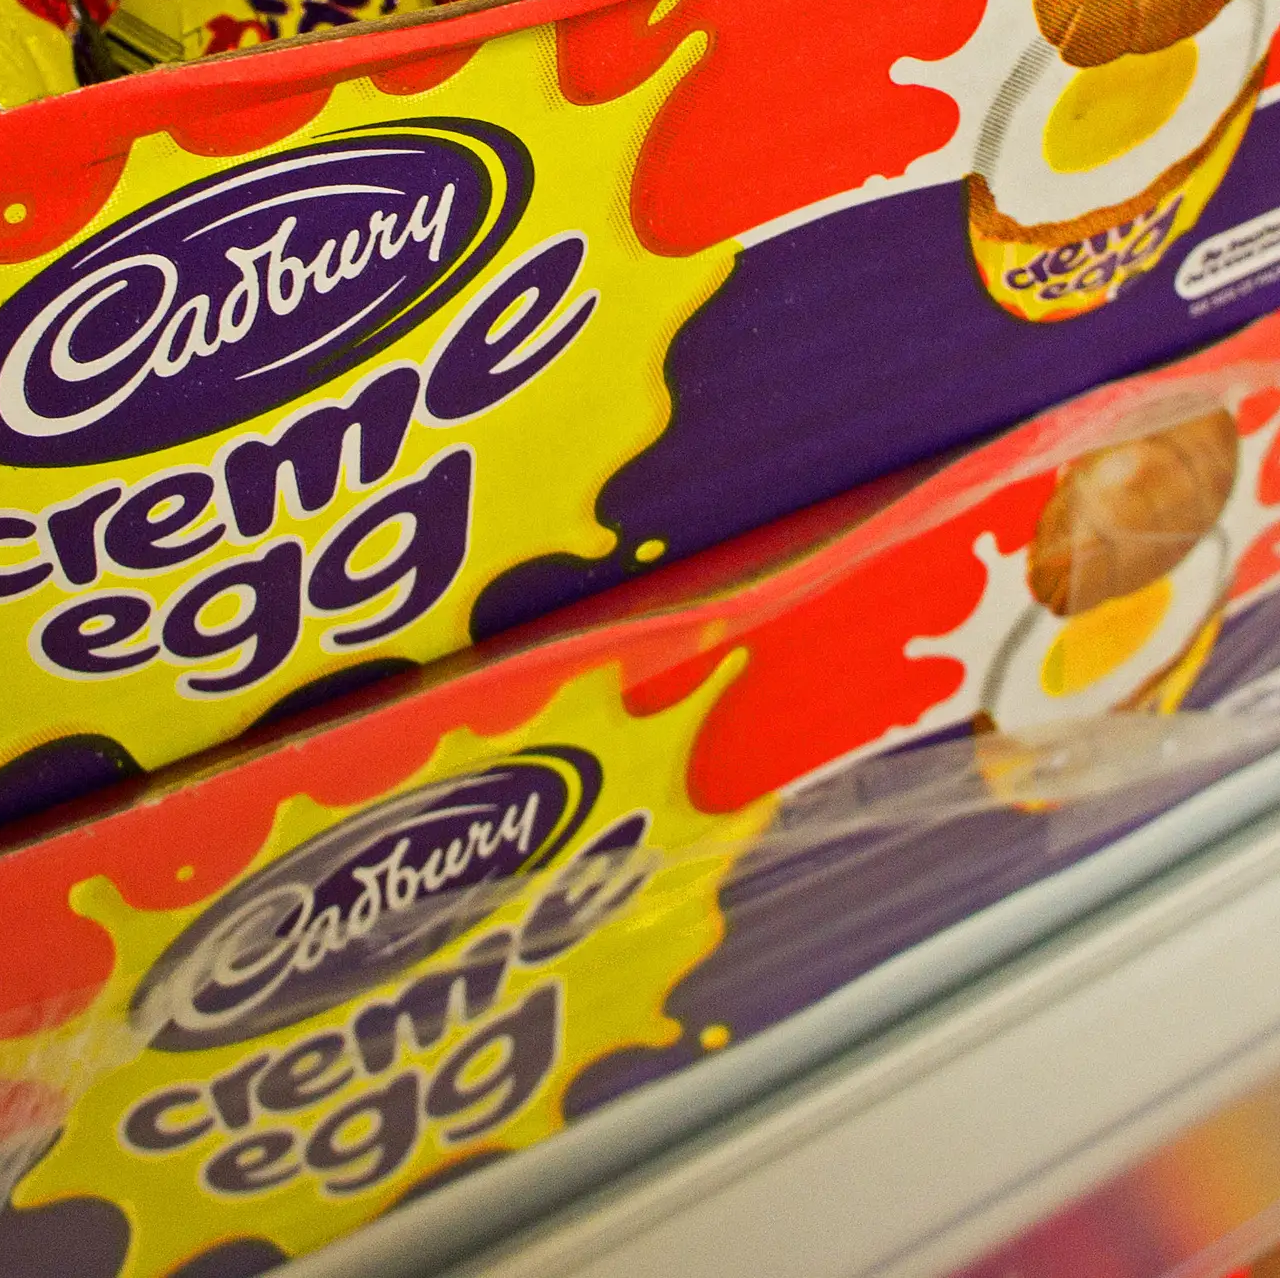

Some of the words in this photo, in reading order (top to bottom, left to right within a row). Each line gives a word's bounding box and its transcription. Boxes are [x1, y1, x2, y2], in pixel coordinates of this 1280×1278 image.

[30, 443, 476, 700] egg
[120, 809, 655, 1156] creme
[165, 793, 538, 1032] Cadbury
[198, 975, 566, 1200] egg
